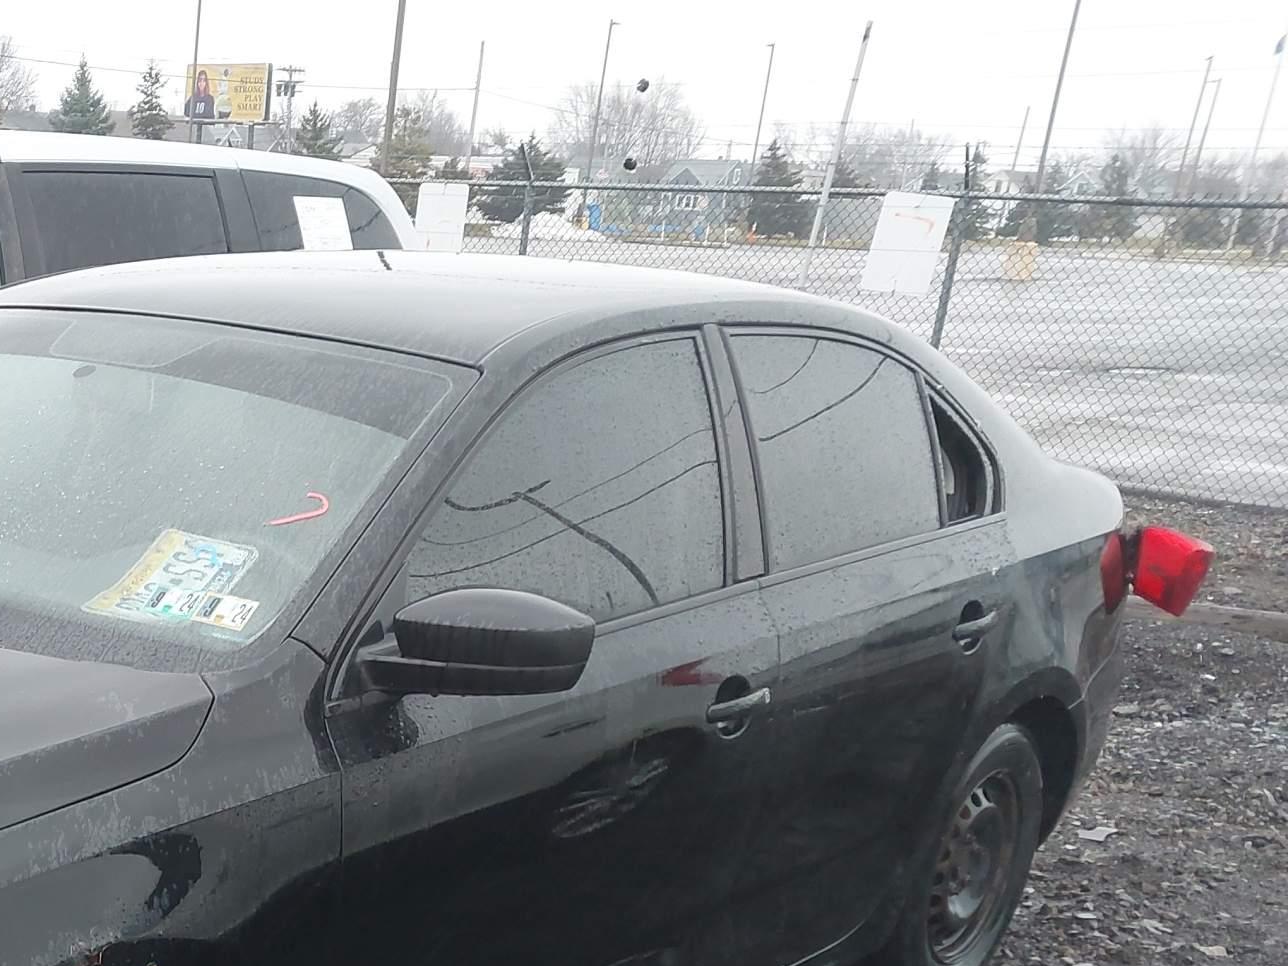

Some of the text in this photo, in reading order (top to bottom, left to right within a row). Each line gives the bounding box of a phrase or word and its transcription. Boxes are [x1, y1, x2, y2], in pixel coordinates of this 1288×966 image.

[241, 76, 264, 85] STUDY
[233, 85, 264, 94] STRONG
[244, 94, 263, 103] PLAY
[195, 102, 205, 114] 10
[237, 102, 262, 112] SMART
[180, 593, 200, 612] 24
[231, 603, 253, 624] 24
